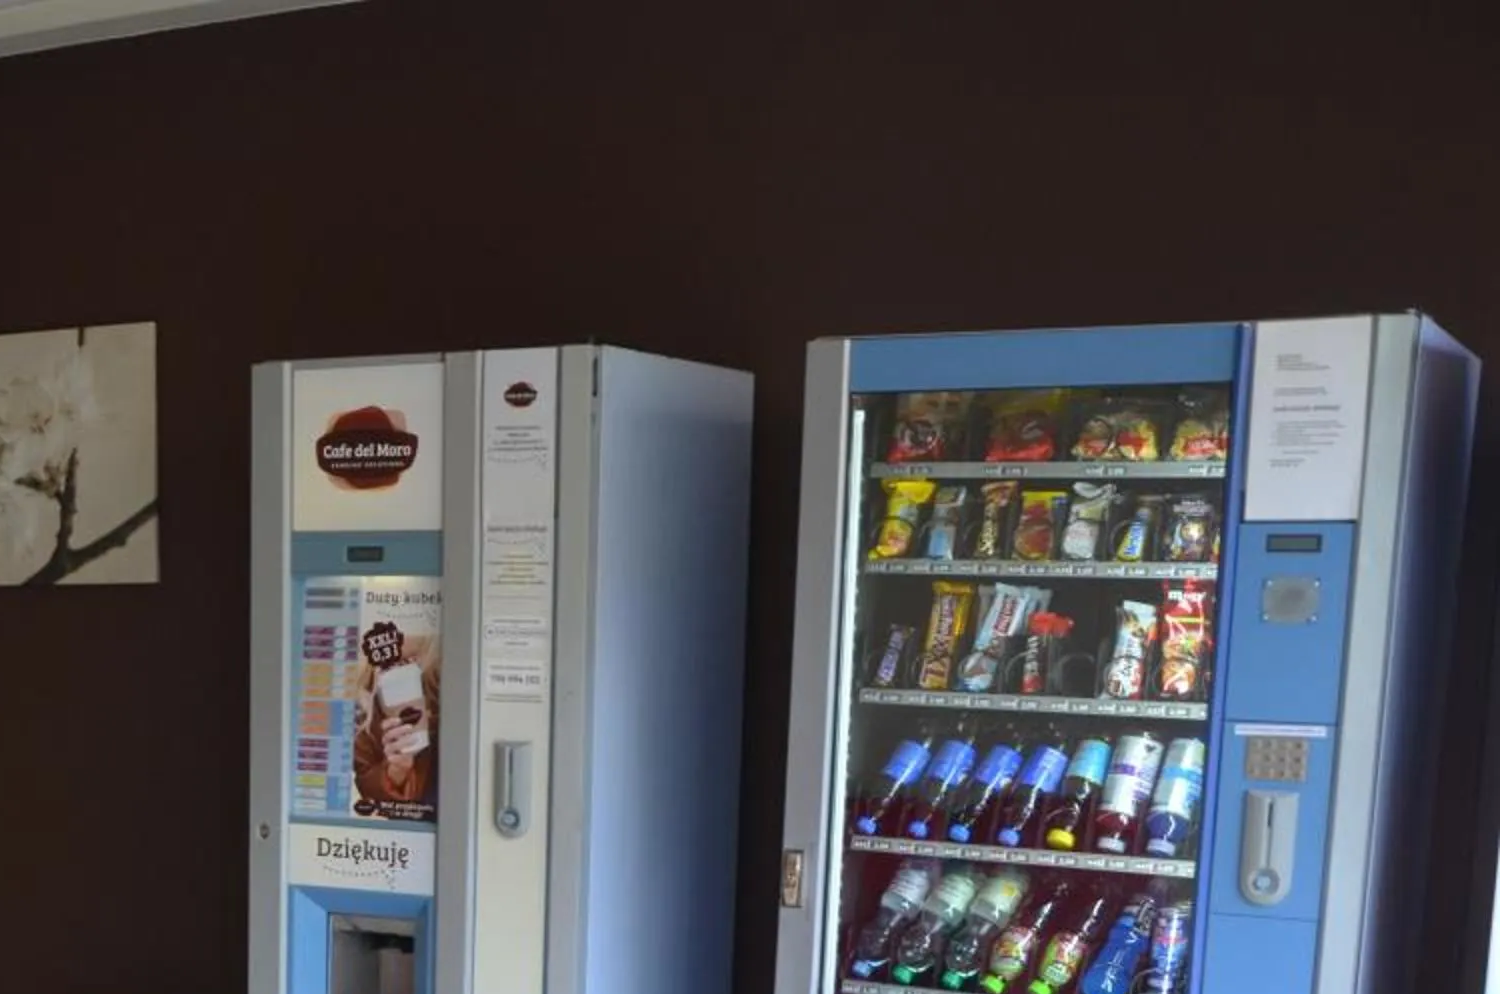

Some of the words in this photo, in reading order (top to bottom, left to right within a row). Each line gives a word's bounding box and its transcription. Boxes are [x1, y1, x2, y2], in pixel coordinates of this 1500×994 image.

[323, 443, 353, 459] Cafe
[354, 442, 375, 458] del
[377, 442, 412, 457] Moro
[316, 837, 410, 869] Dziękuję
